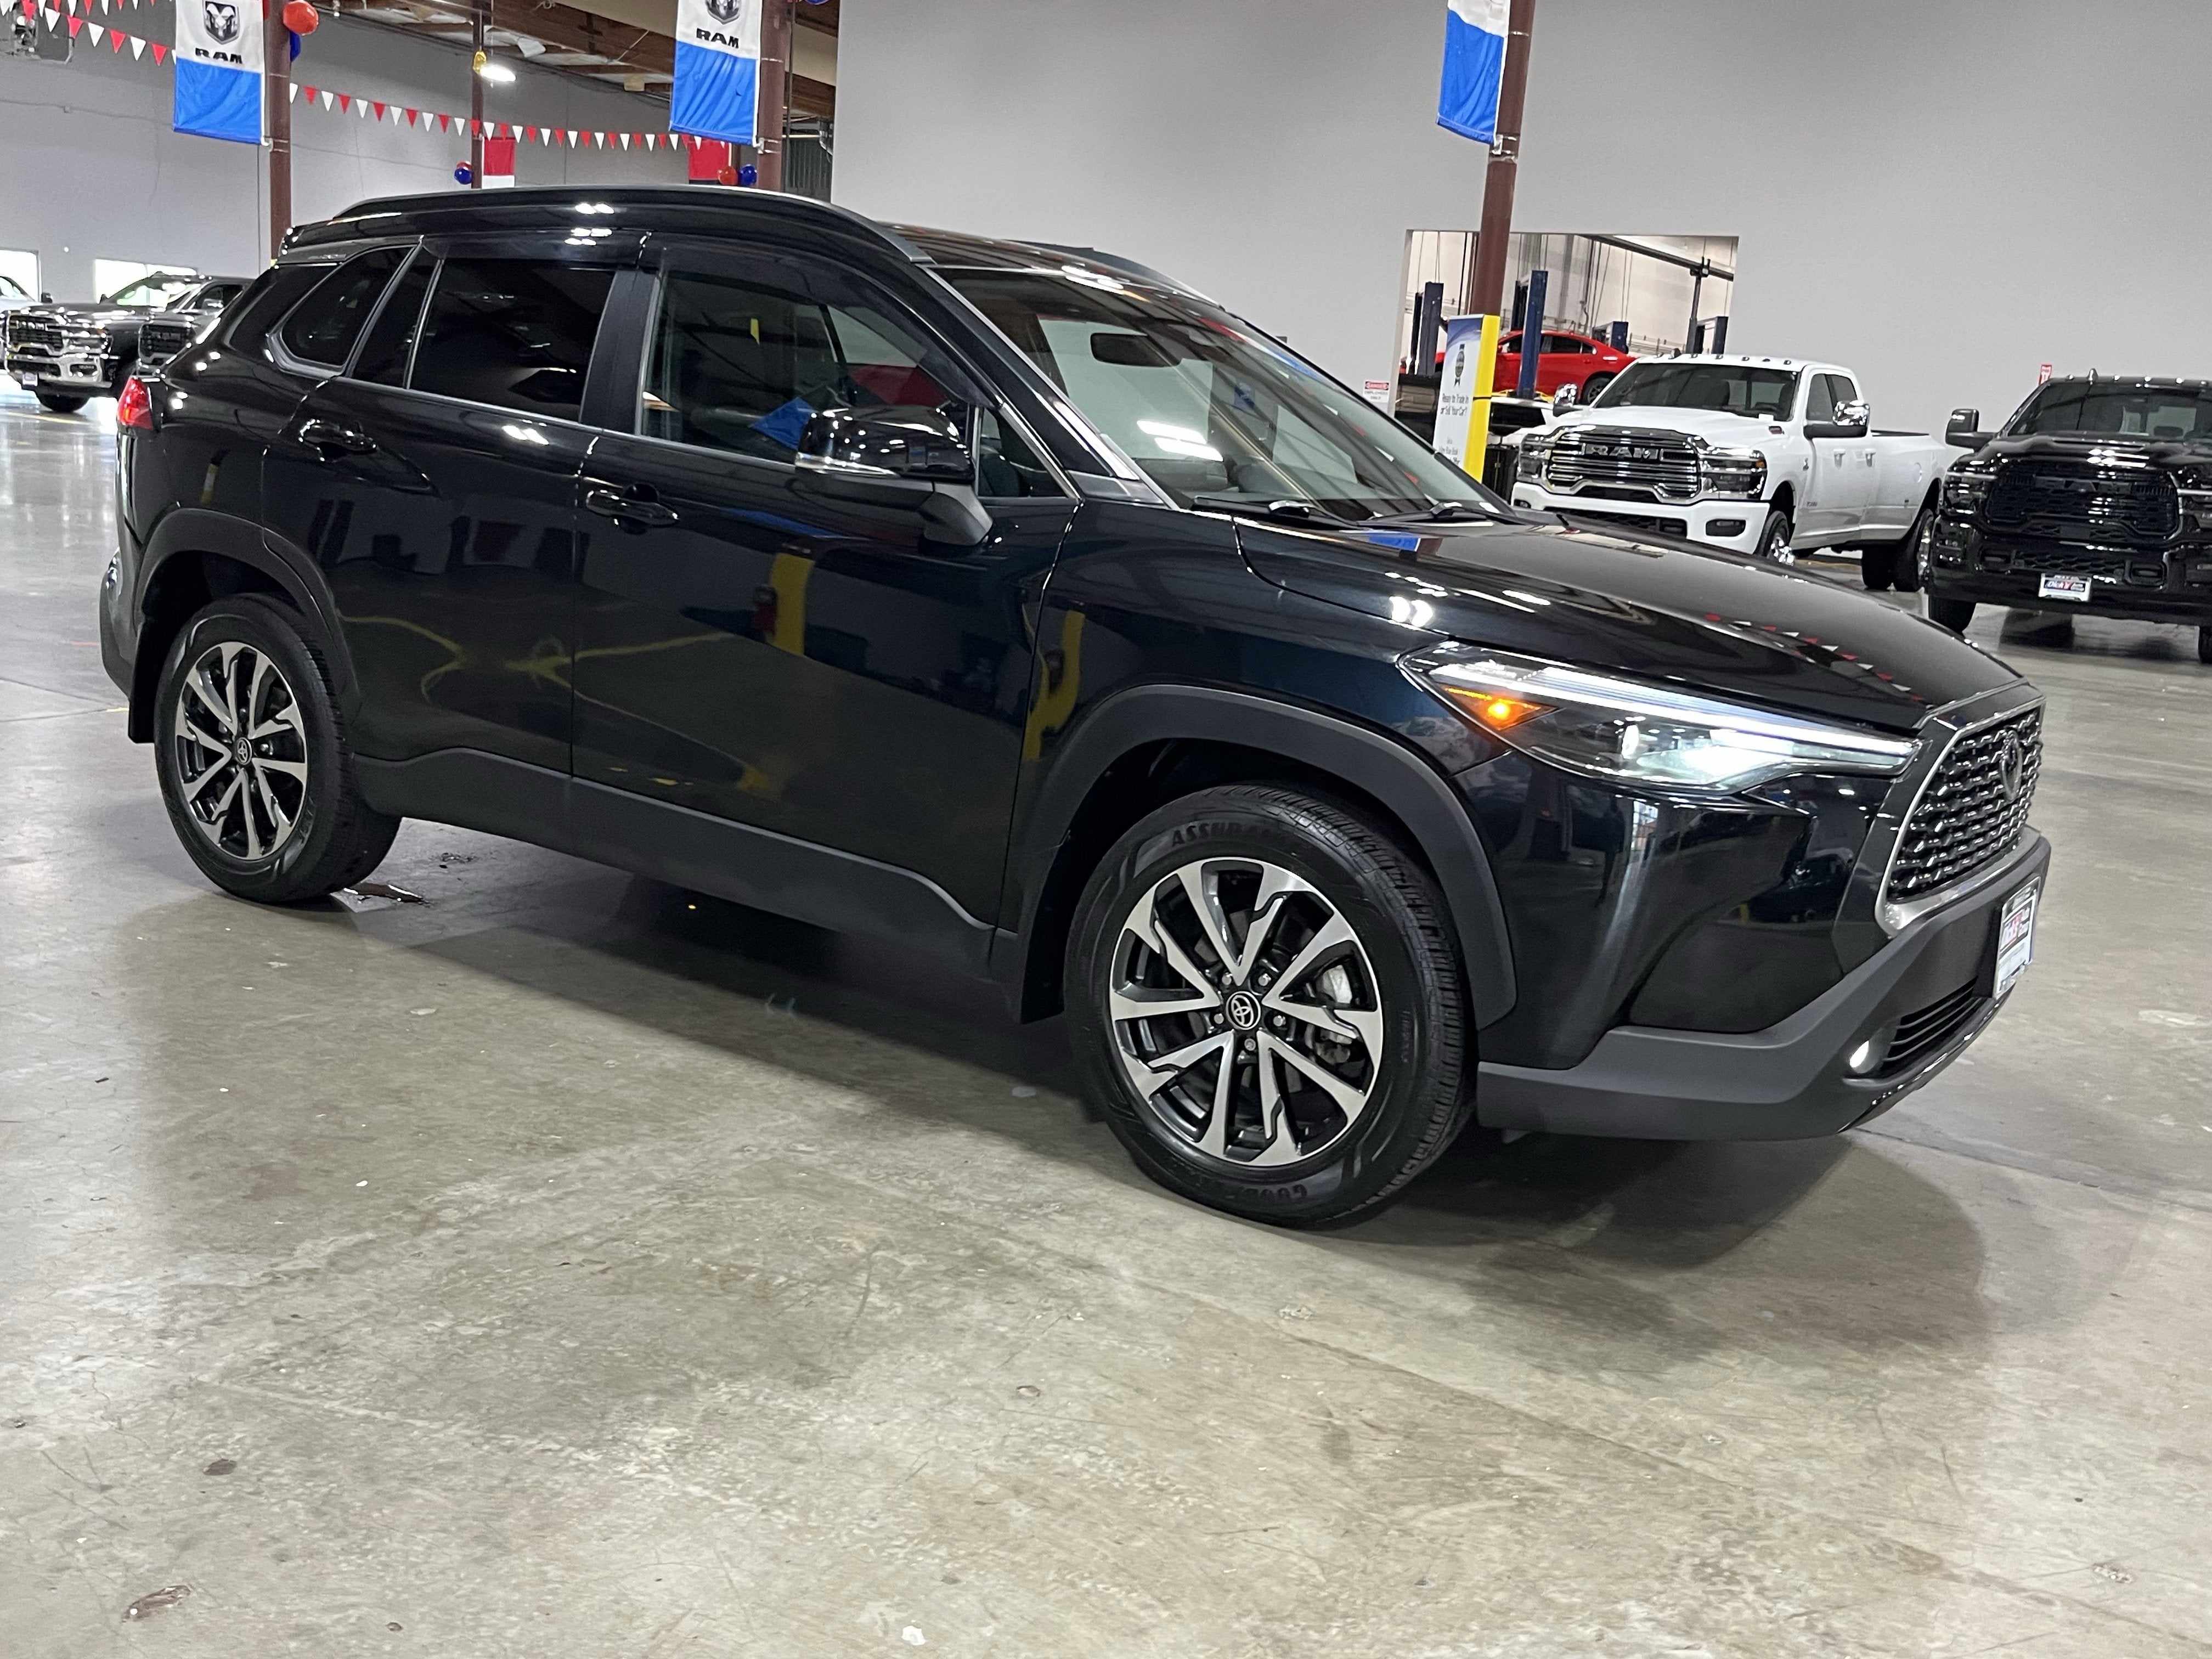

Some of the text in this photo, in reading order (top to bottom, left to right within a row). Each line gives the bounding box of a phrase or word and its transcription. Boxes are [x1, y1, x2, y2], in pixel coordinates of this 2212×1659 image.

[696, 28, 739, 49] RAM
[195, 48, 242, 64] RAM
[1585, 444, 1658, 460] RAM
